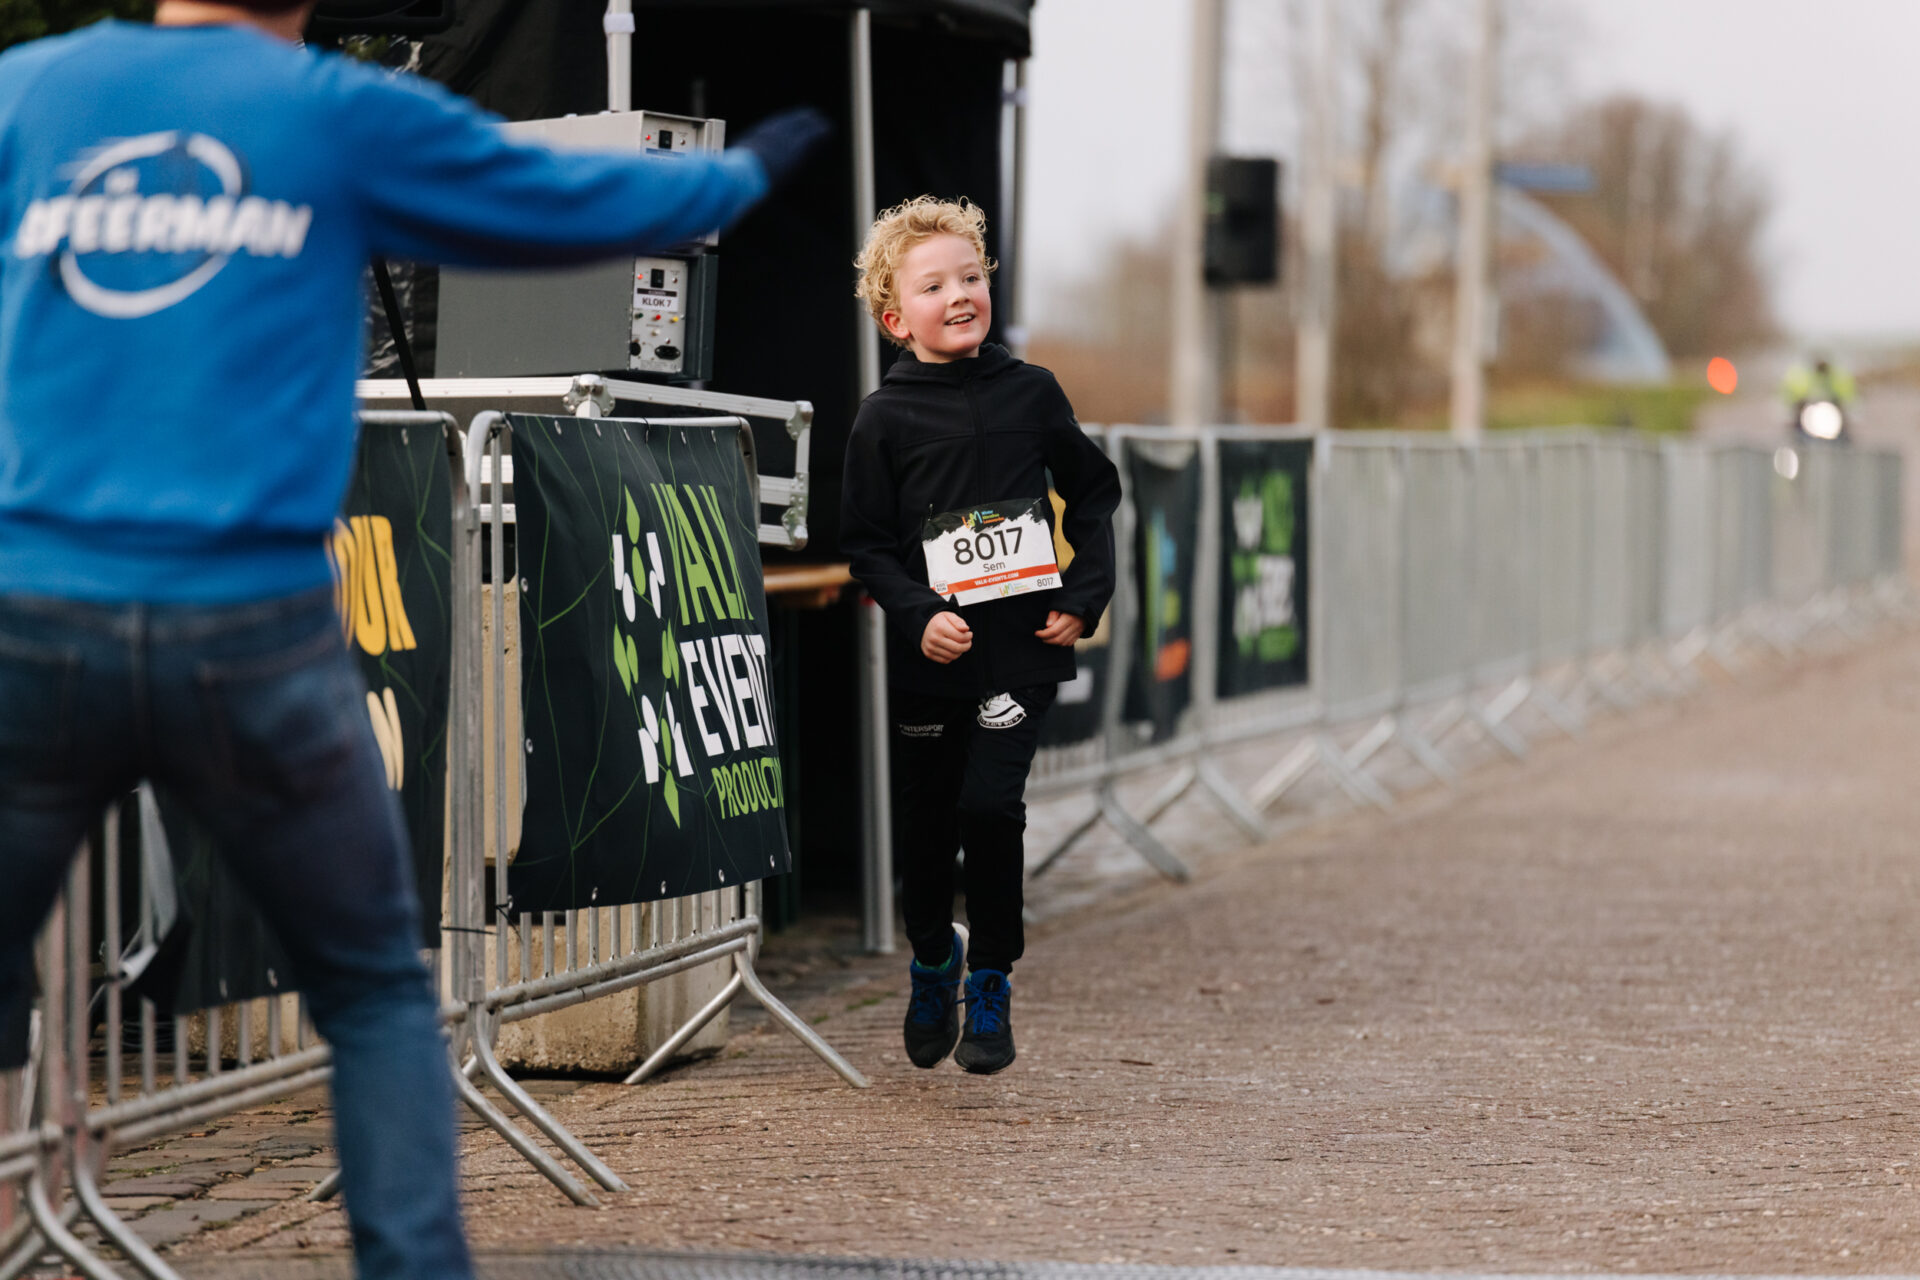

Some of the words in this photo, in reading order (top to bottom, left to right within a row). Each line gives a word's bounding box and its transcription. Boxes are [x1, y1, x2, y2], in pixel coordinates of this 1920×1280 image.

[642, 297, 665, 307] KLOK
[666, 299, 672, 308] 7
[954, 526, 1023, 565] 8017
[983, 562, 1006, 573] Sem
[1036, 577, 1054, 588] 8017
